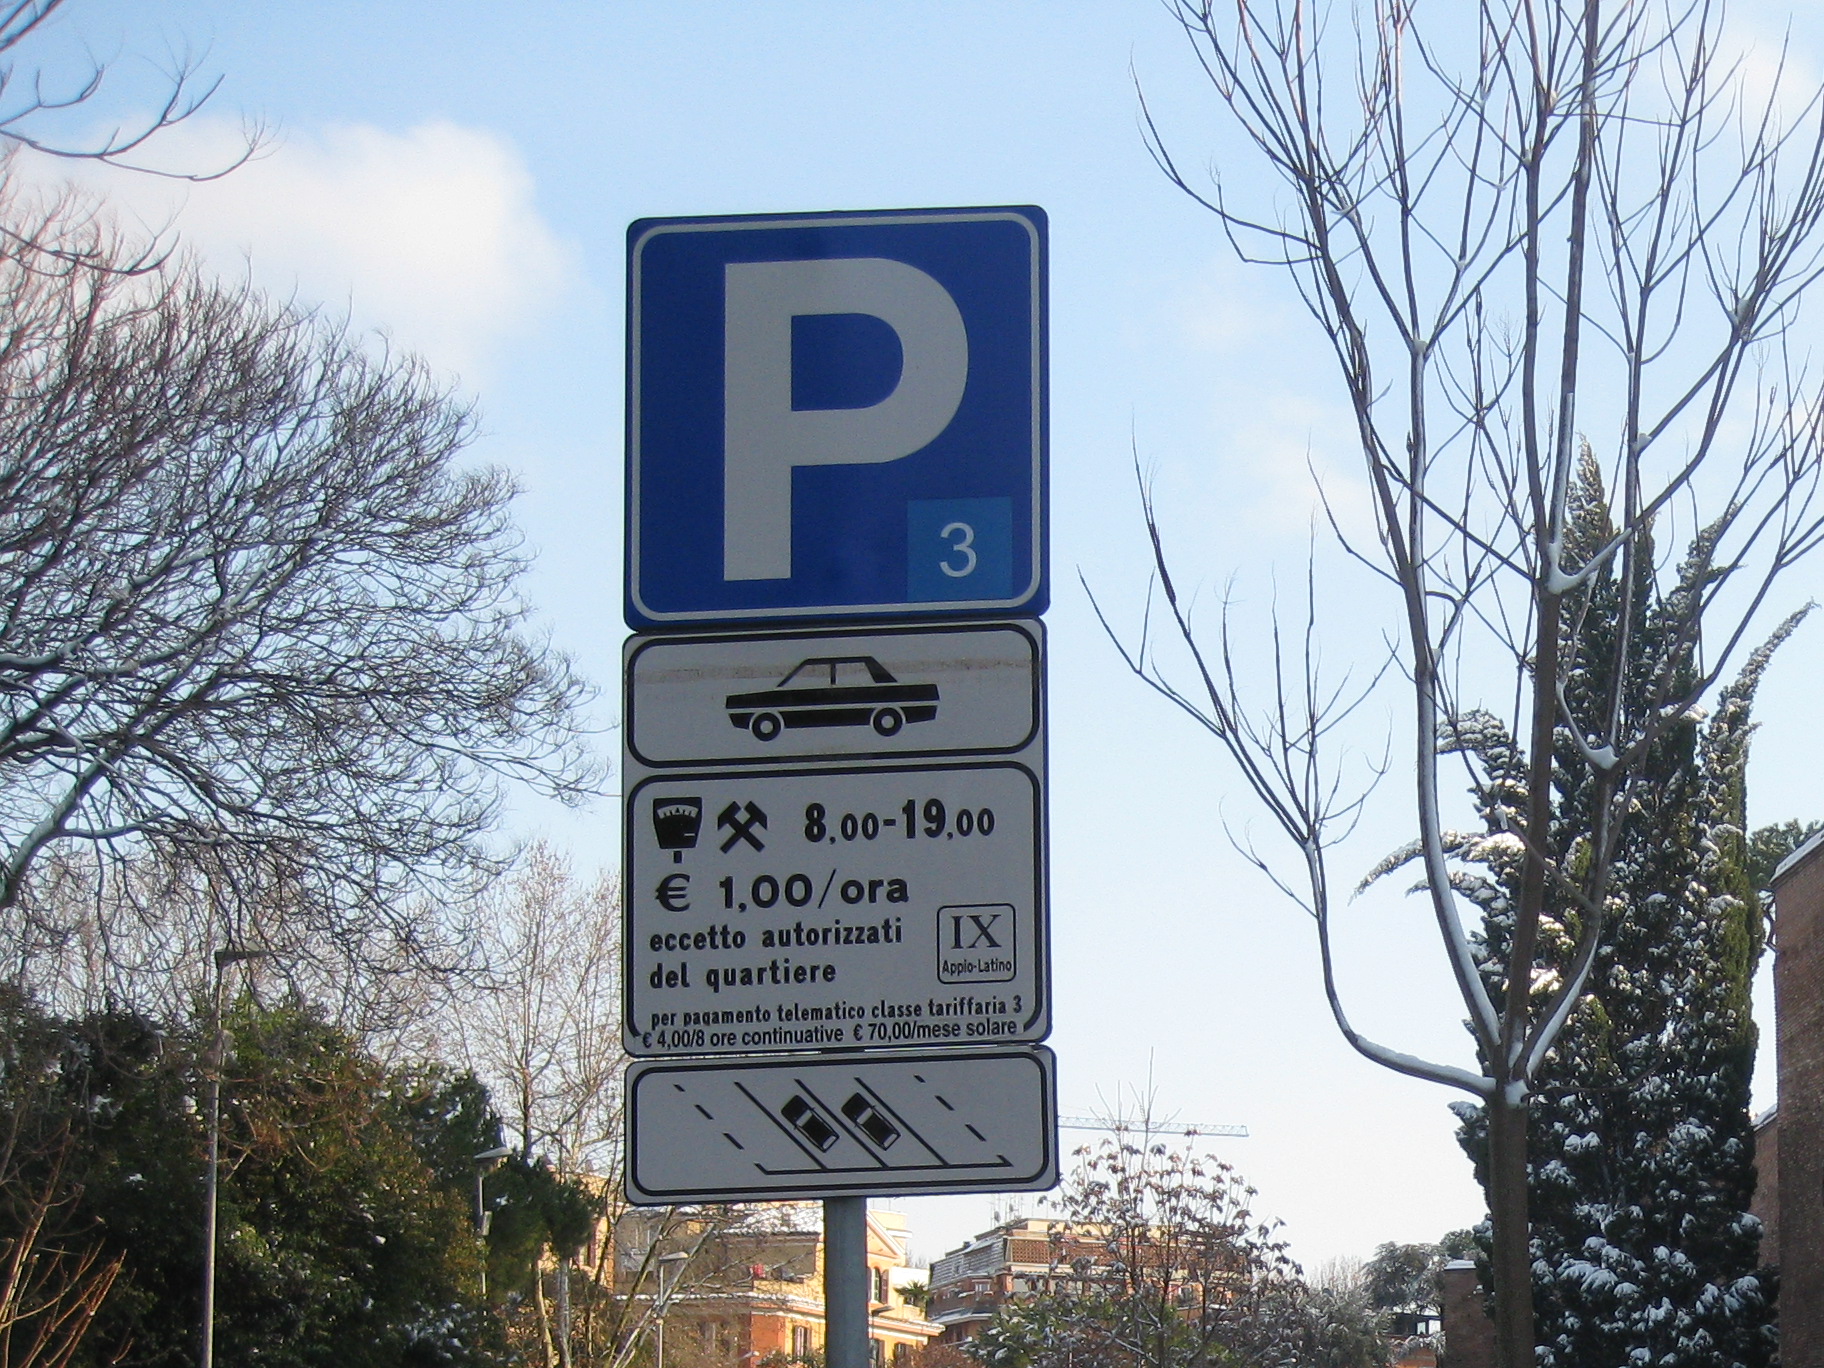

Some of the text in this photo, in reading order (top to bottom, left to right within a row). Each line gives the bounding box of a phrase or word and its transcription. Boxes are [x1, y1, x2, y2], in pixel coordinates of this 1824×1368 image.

[724, 258, 968, 581] P
[939, 522, 978, 578] 3
[655, 869, 910, 912] € 1,00/ora
[649, 917, 903, 953] eccetto autorizzati
[951, 914, 1002, 949] IX
[649, 958, 837, 993] del quartiere
[942, 958, 1012, 976] Appio-Latino
[651, 995, 1023, 1031] per pagamento telematico classe tariffaria 3
[642, 1018, 1017, 1050] € 4,00/8 ore continuative € 70,00/mese solare
